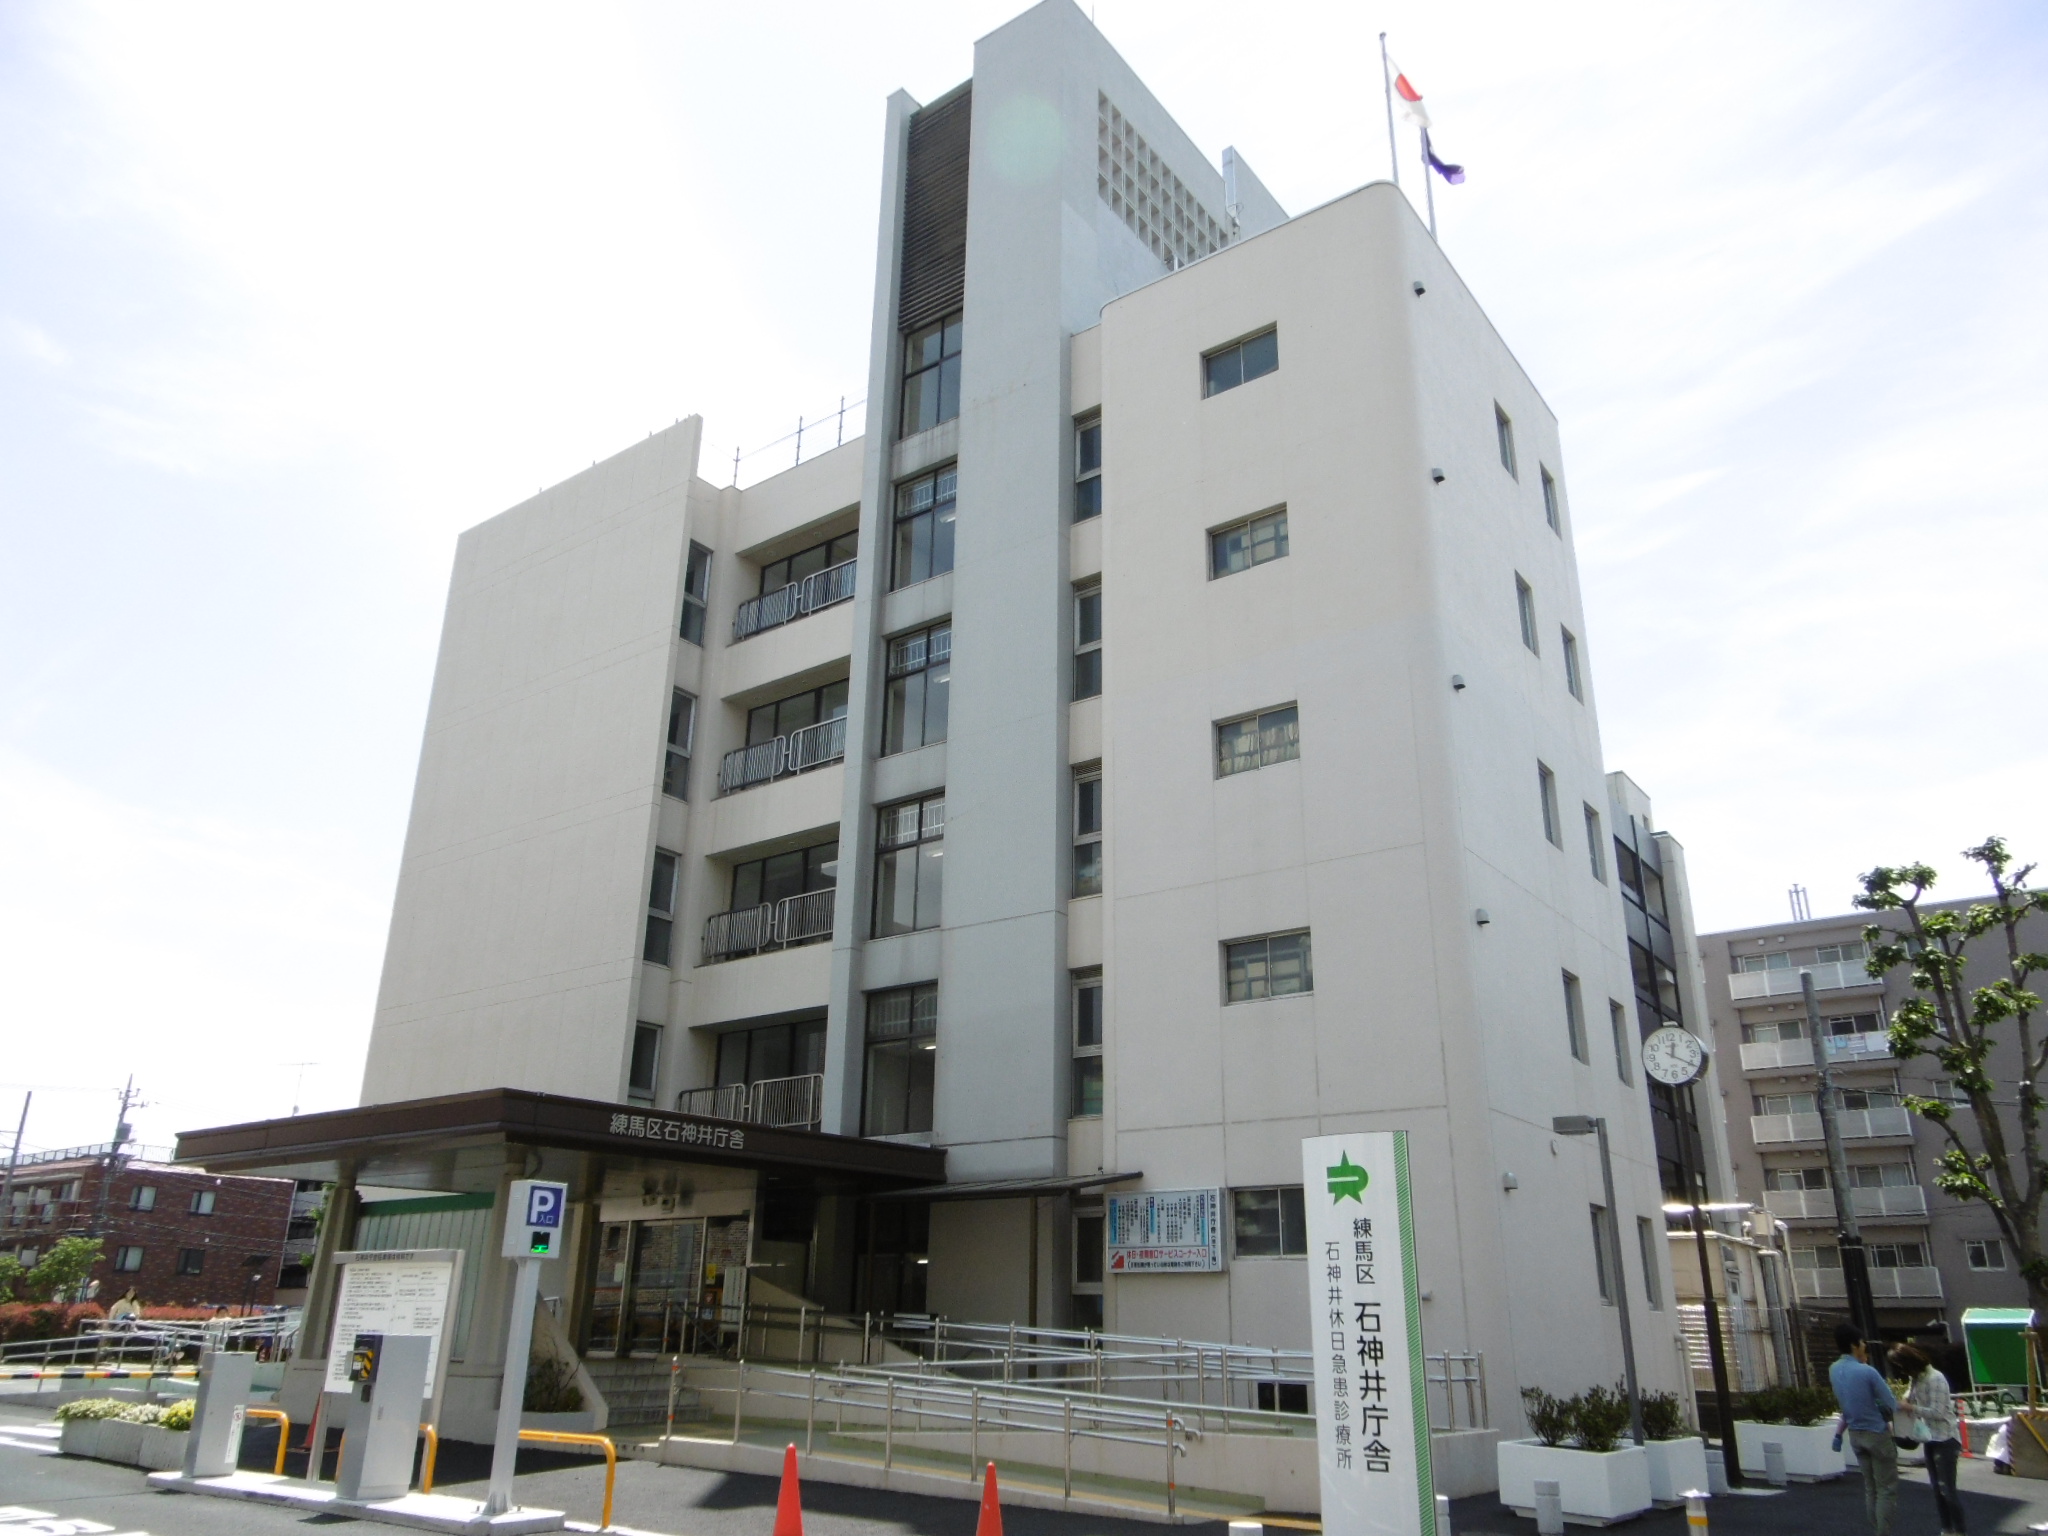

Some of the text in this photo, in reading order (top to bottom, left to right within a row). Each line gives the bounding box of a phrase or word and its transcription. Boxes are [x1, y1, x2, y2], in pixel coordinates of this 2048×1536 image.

[1657, 1035, 1665, 1044] 11
[1666, 1033, 1675, 1041] 12
[1650, 1044, 1659, 1052] 10
[1685, 1040, 1694, 1049] 2
[1649, 1054, 1656, 1062] 9
[1690, 1049, 1696, 1058] 3
[1653, 1062, 1660, 1070] 8
[1662, 1069, 1668, 1077] 7
[1671, 1070, 1678, 1079] 6
[1681, 1067, 1688, 1075] 5
[609, 1112, 745, 1150] 練馬区石神井庁舎
[530, 1189, 554, 1224] P
[538, 1214, 554, 1224] 入口
[1352, 1217, 1391, 1474] 練馬区 石神井庁舎
[1325, 1241, 1353, 1470] 石神井休日急患診療所
